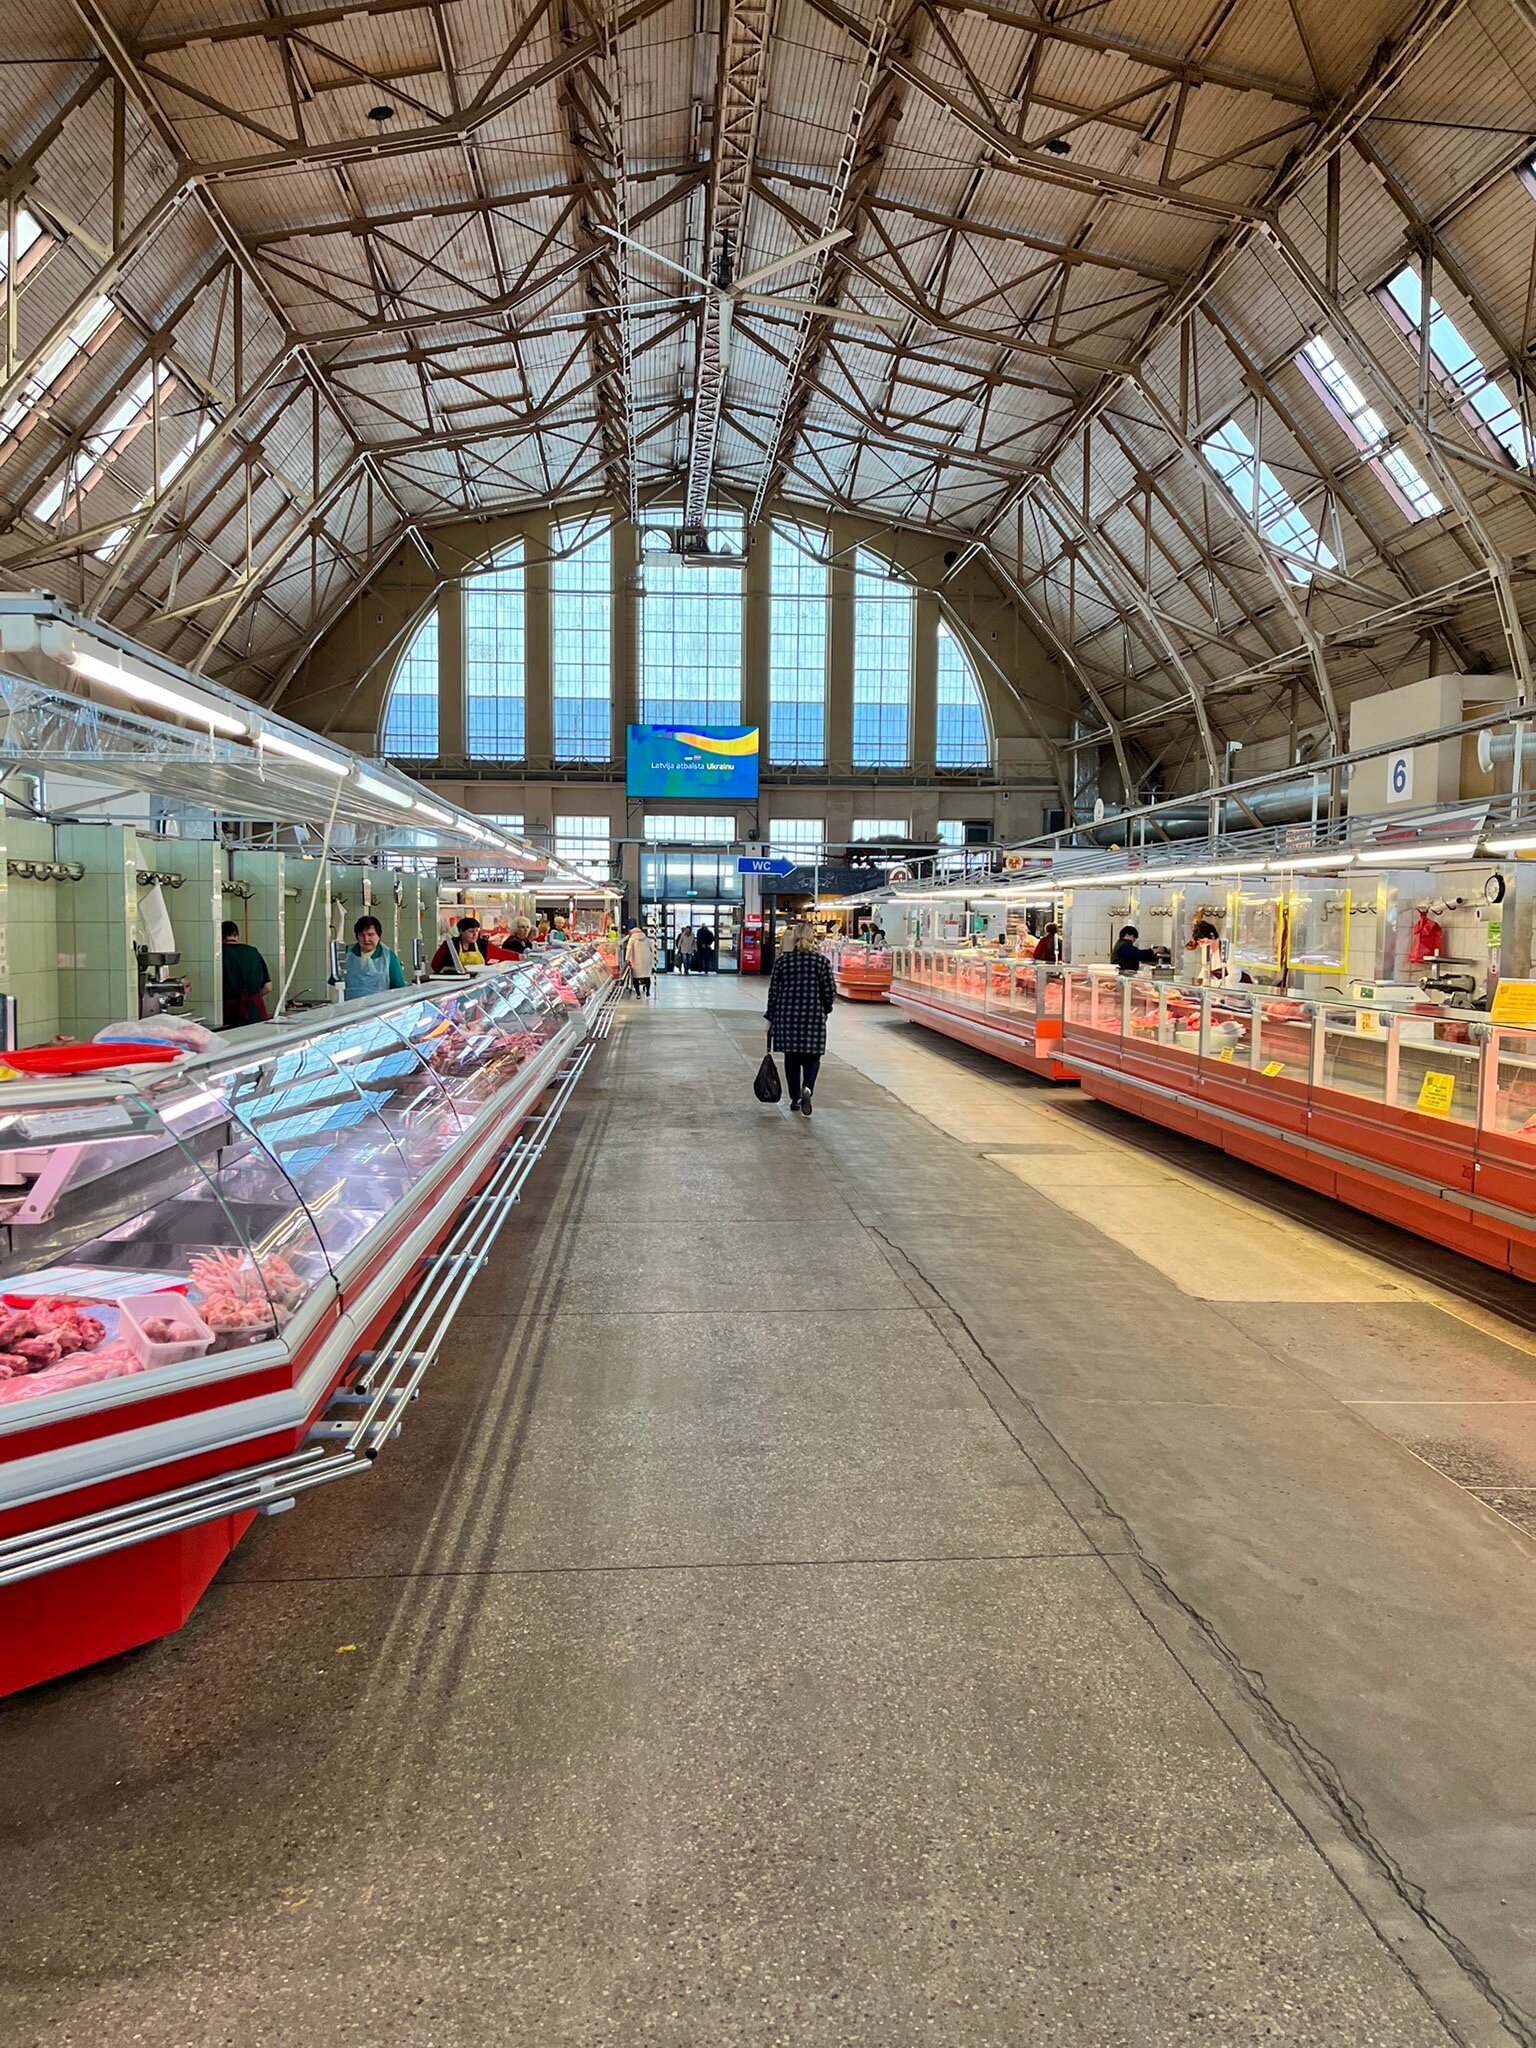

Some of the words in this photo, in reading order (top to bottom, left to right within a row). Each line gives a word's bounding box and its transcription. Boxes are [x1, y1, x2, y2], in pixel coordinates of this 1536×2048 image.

[651, 762, 675, 770] Latvija
[706, 762, 735, 771] Ukrainu
[1393, 758, 1407, 794] 6
[752, 861, 772, 871] WC
